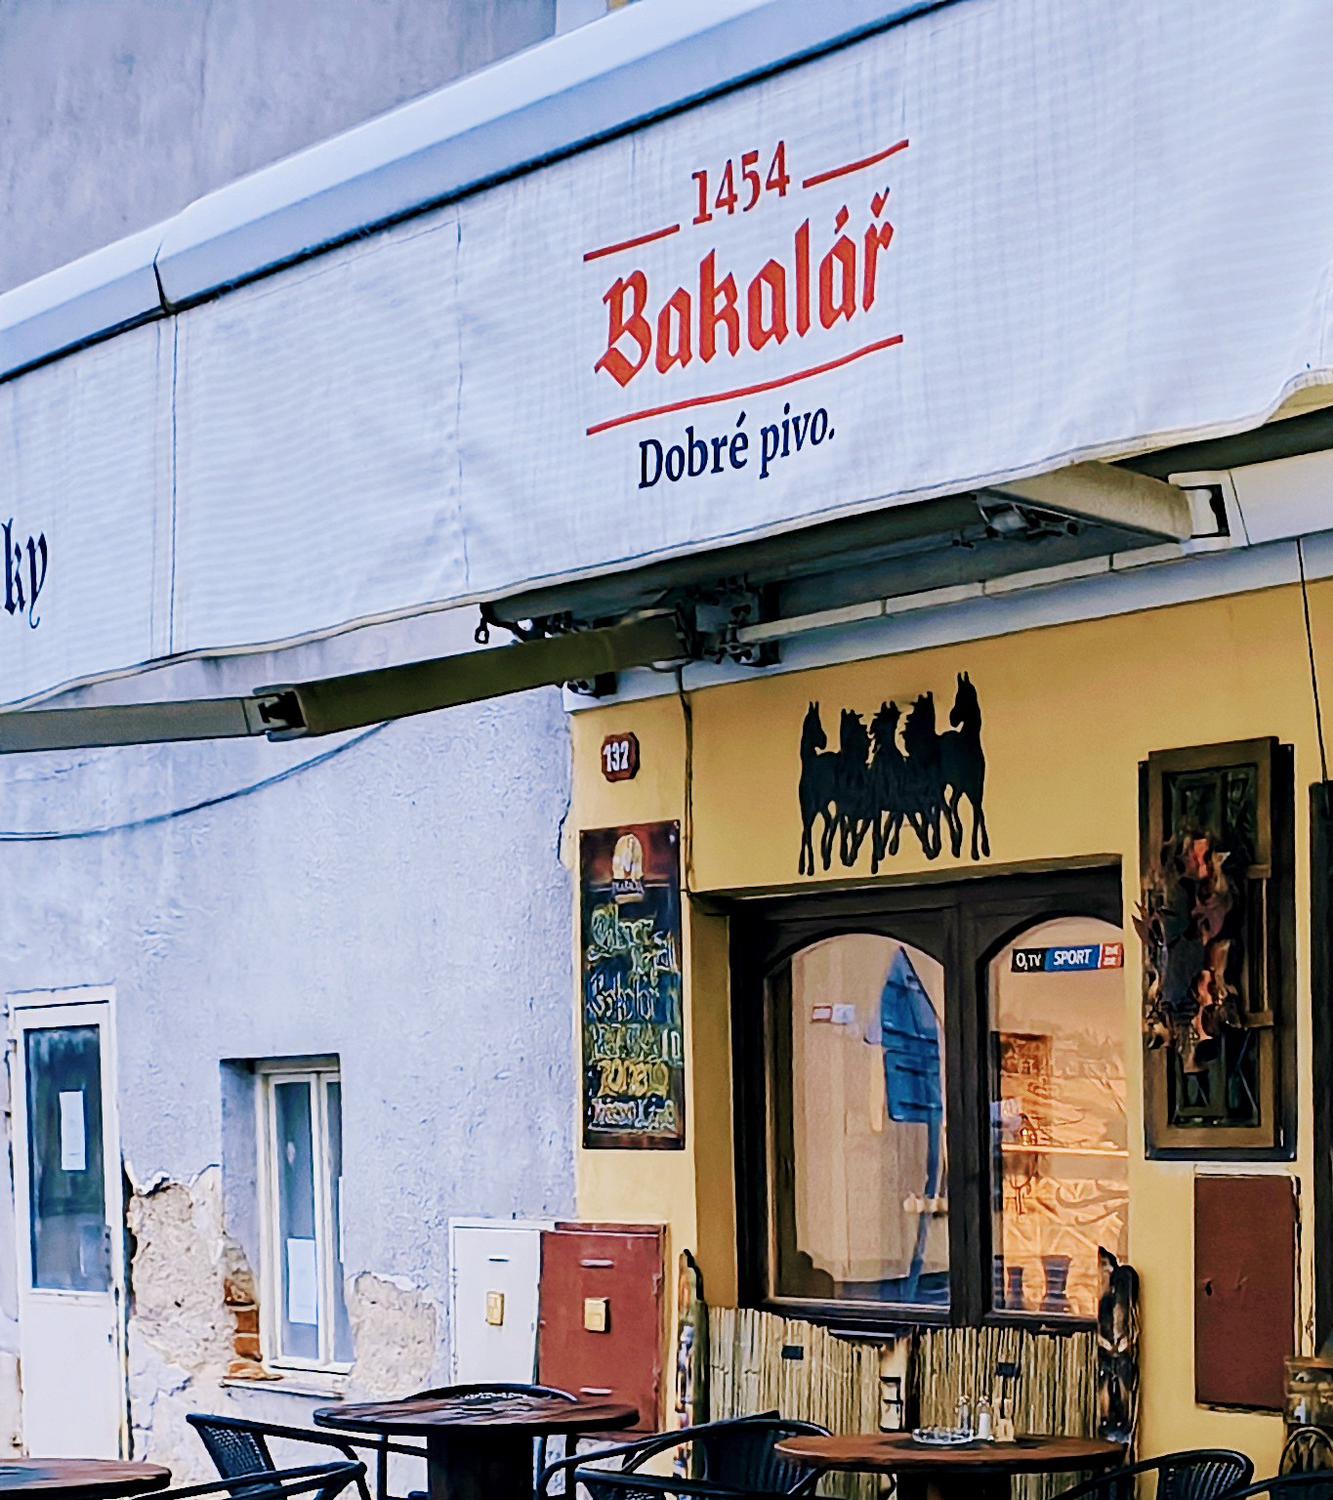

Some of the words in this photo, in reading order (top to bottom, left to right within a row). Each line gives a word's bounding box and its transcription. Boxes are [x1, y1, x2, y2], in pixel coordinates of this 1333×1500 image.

[691, 140, 790, 225] 1454
[594, 187, 894, 388] Bakalář
[638, 410, 749, 489] Dobré
[759, 402, 836, 480] pivo.
[1053, 948, 1093, 966] SPORT
